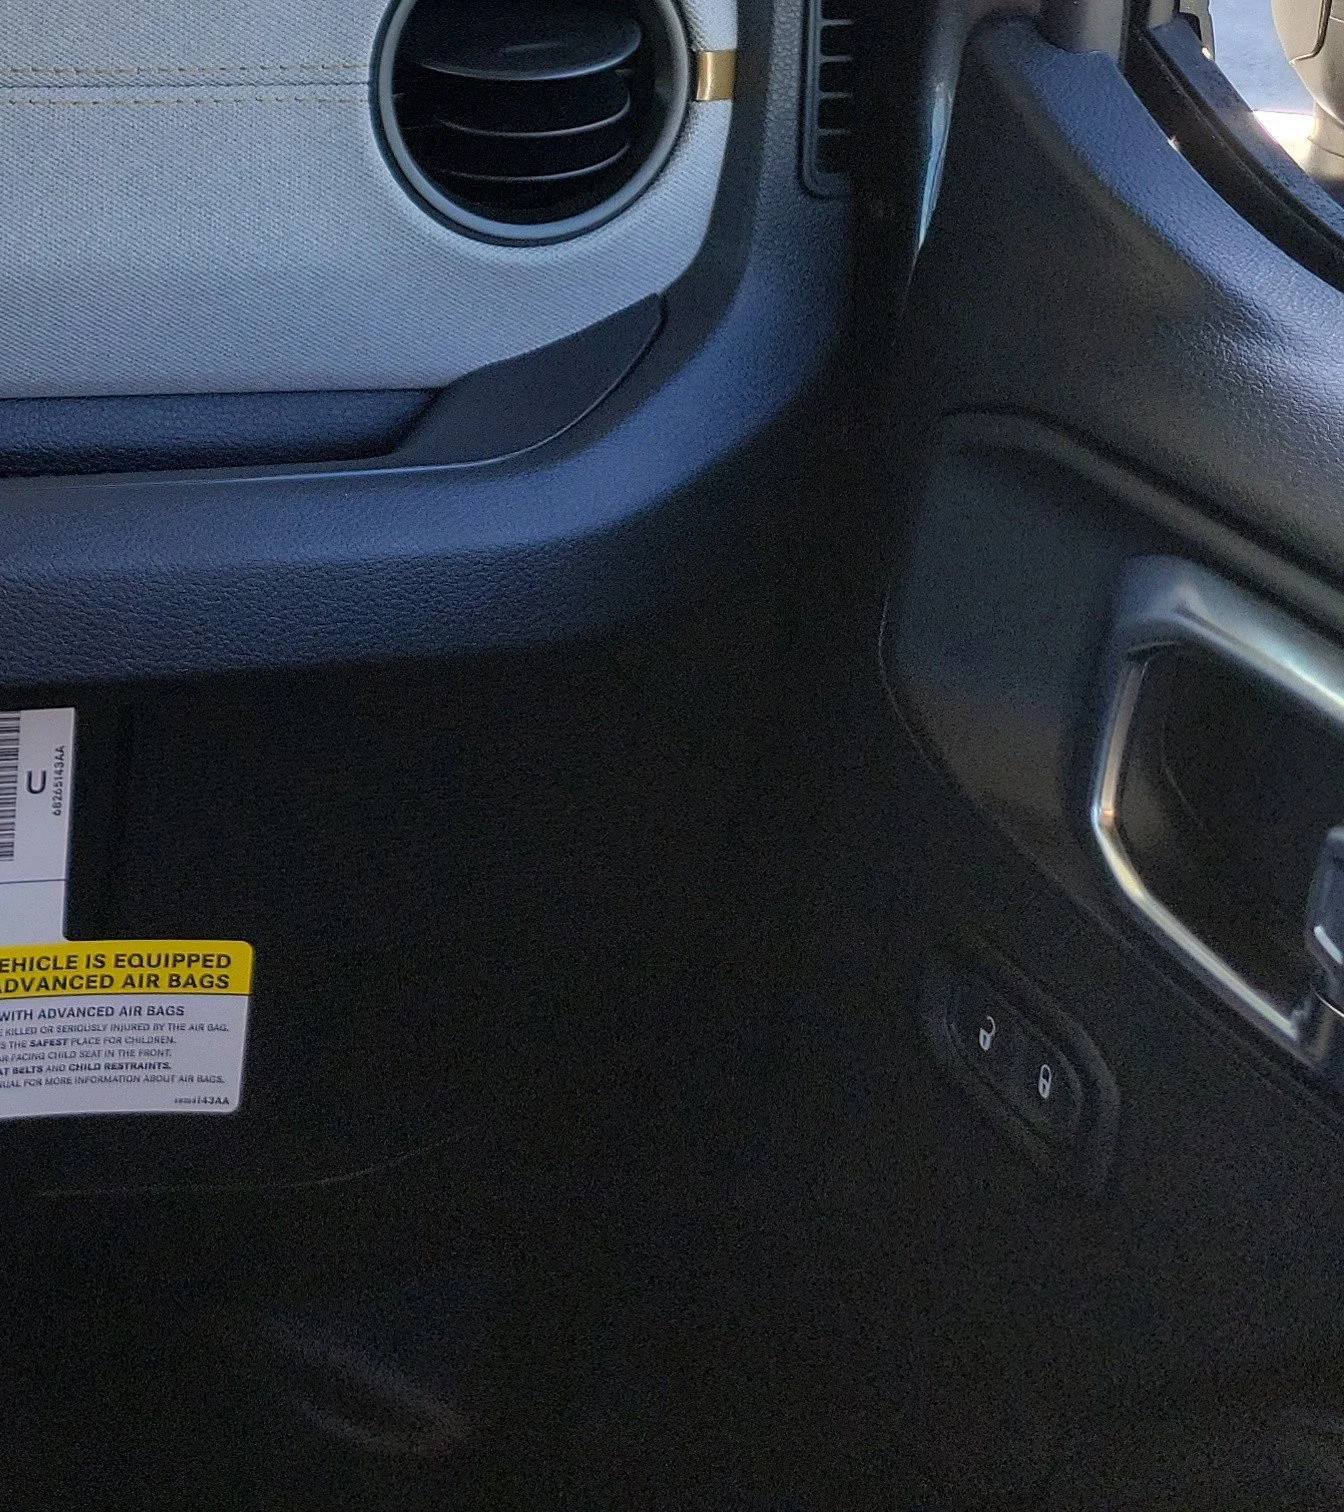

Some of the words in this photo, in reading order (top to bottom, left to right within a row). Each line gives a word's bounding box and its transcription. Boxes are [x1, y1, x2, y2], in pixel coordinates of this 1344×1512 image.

[85, 953, 106, 969] IS
[114, 953, 232, 969] EQUIPPED
[122, 973, 160, 989] AIR
[168, 973, 230, 989] BAGS
[37, 1006, 114, 1020] ADVANCED
[118, 1006, 142, 1017] AIR
[146, 1005, 185, 1017] BAGS
[5, 1026, 38, 1036] KILLED
[110, 1023, 150, 1032] INJURED
[167, 1023, 186, 1031] THE
[188, 1023, 205, 1032] AIR
[29, 1037, 68, 1048] SAFEST
